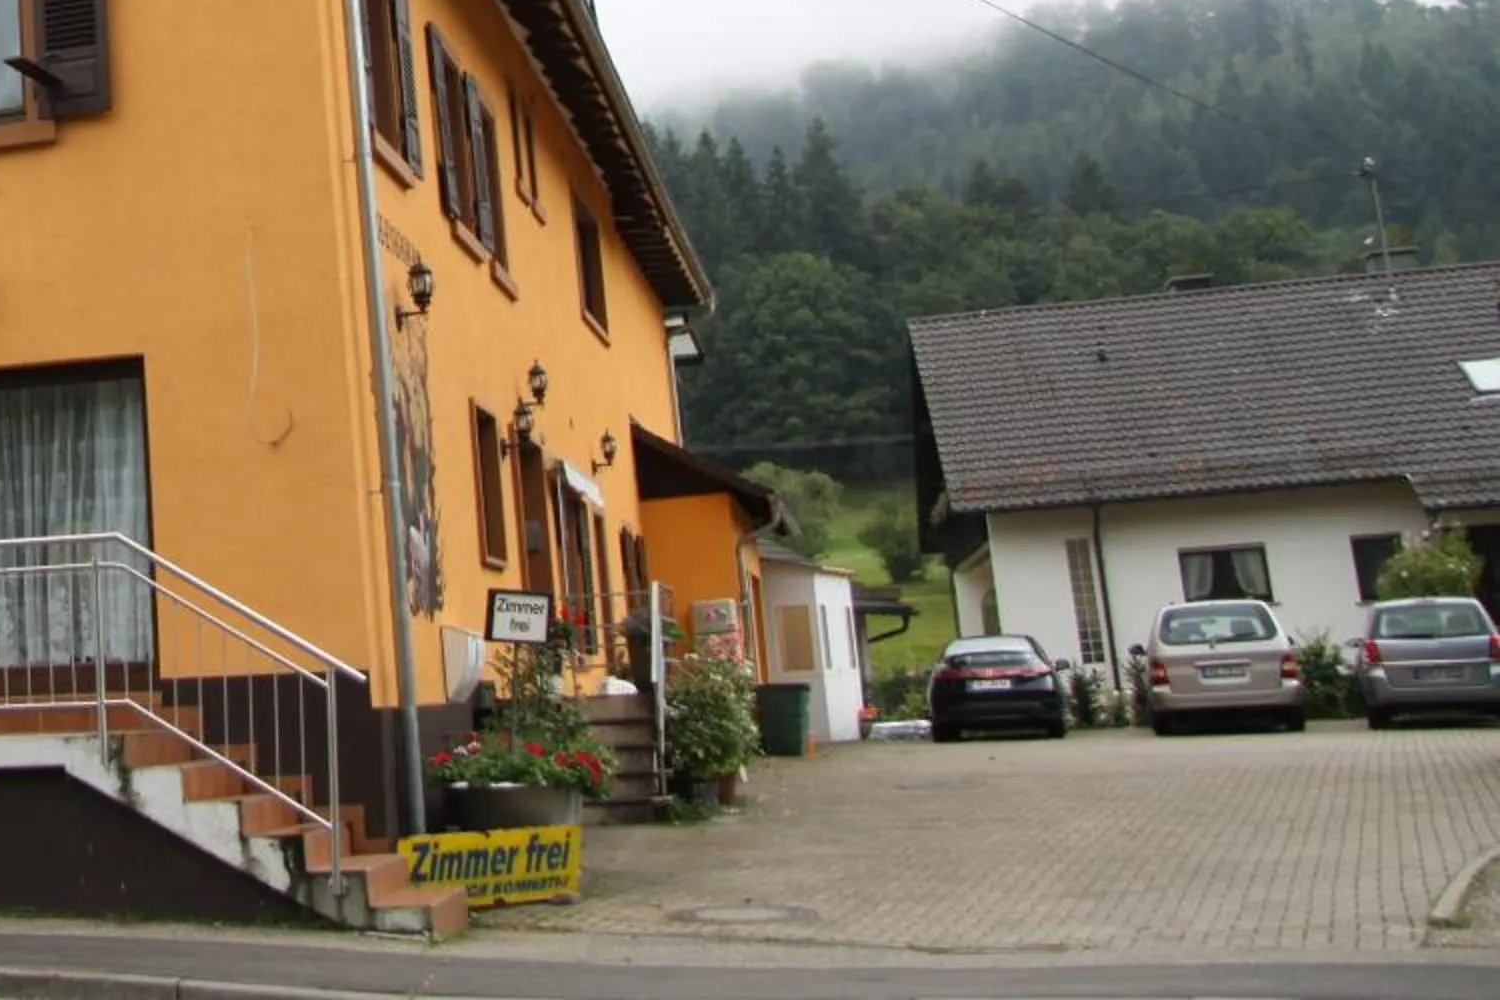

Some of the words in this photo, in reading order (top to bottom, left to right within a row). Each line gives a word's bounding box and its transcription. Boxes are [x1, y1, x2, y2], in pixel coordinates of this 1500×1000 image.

[496, 597, 545, 615] Zimmer
[510, 617, 531, 633] frei
[411, 842, 519, 883] Zimmer
[525, 831, 572, 873] frei
